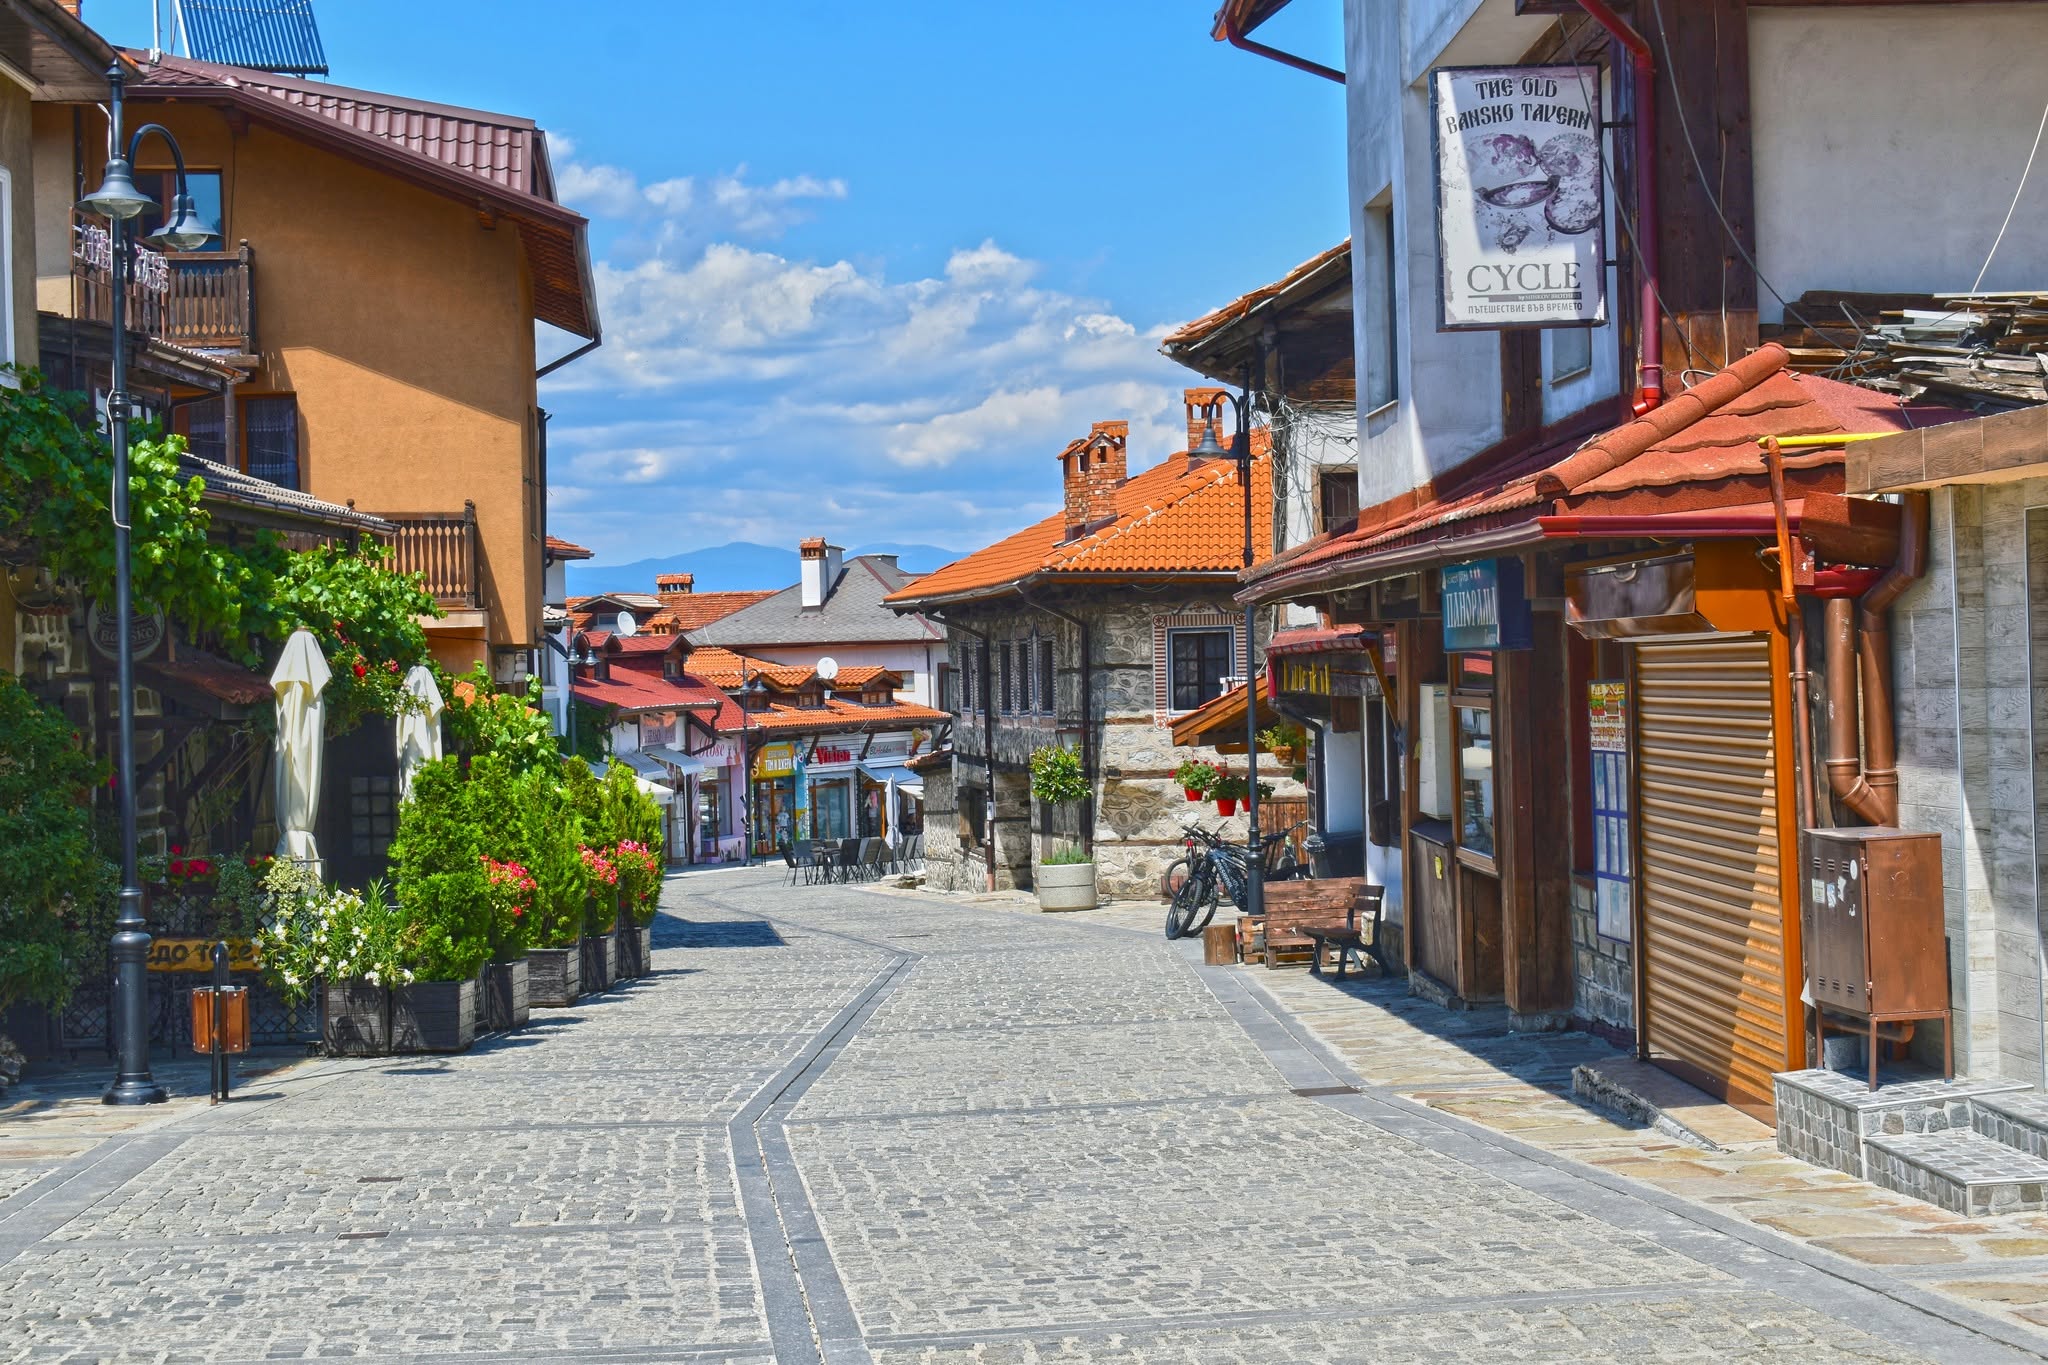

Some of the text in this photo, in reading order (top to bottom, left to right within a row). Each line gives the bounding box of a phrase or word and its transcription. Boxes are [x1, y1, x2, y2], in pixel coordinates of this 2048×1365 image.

[1475, 77, 1557, 100] THE OLD
[1445, 103, 1591, 134] BANSKO TAVERN
[1467, 262, 1581, 292] CYCLE
[1468, 302, 1582, 314] ПЪТЕШЕСТВИЕ ВЪВ ВРЕМЕТО
[1446, 587, 1498, 628] ПАНОРАМА
[816, 745, 851, 765] Vision
